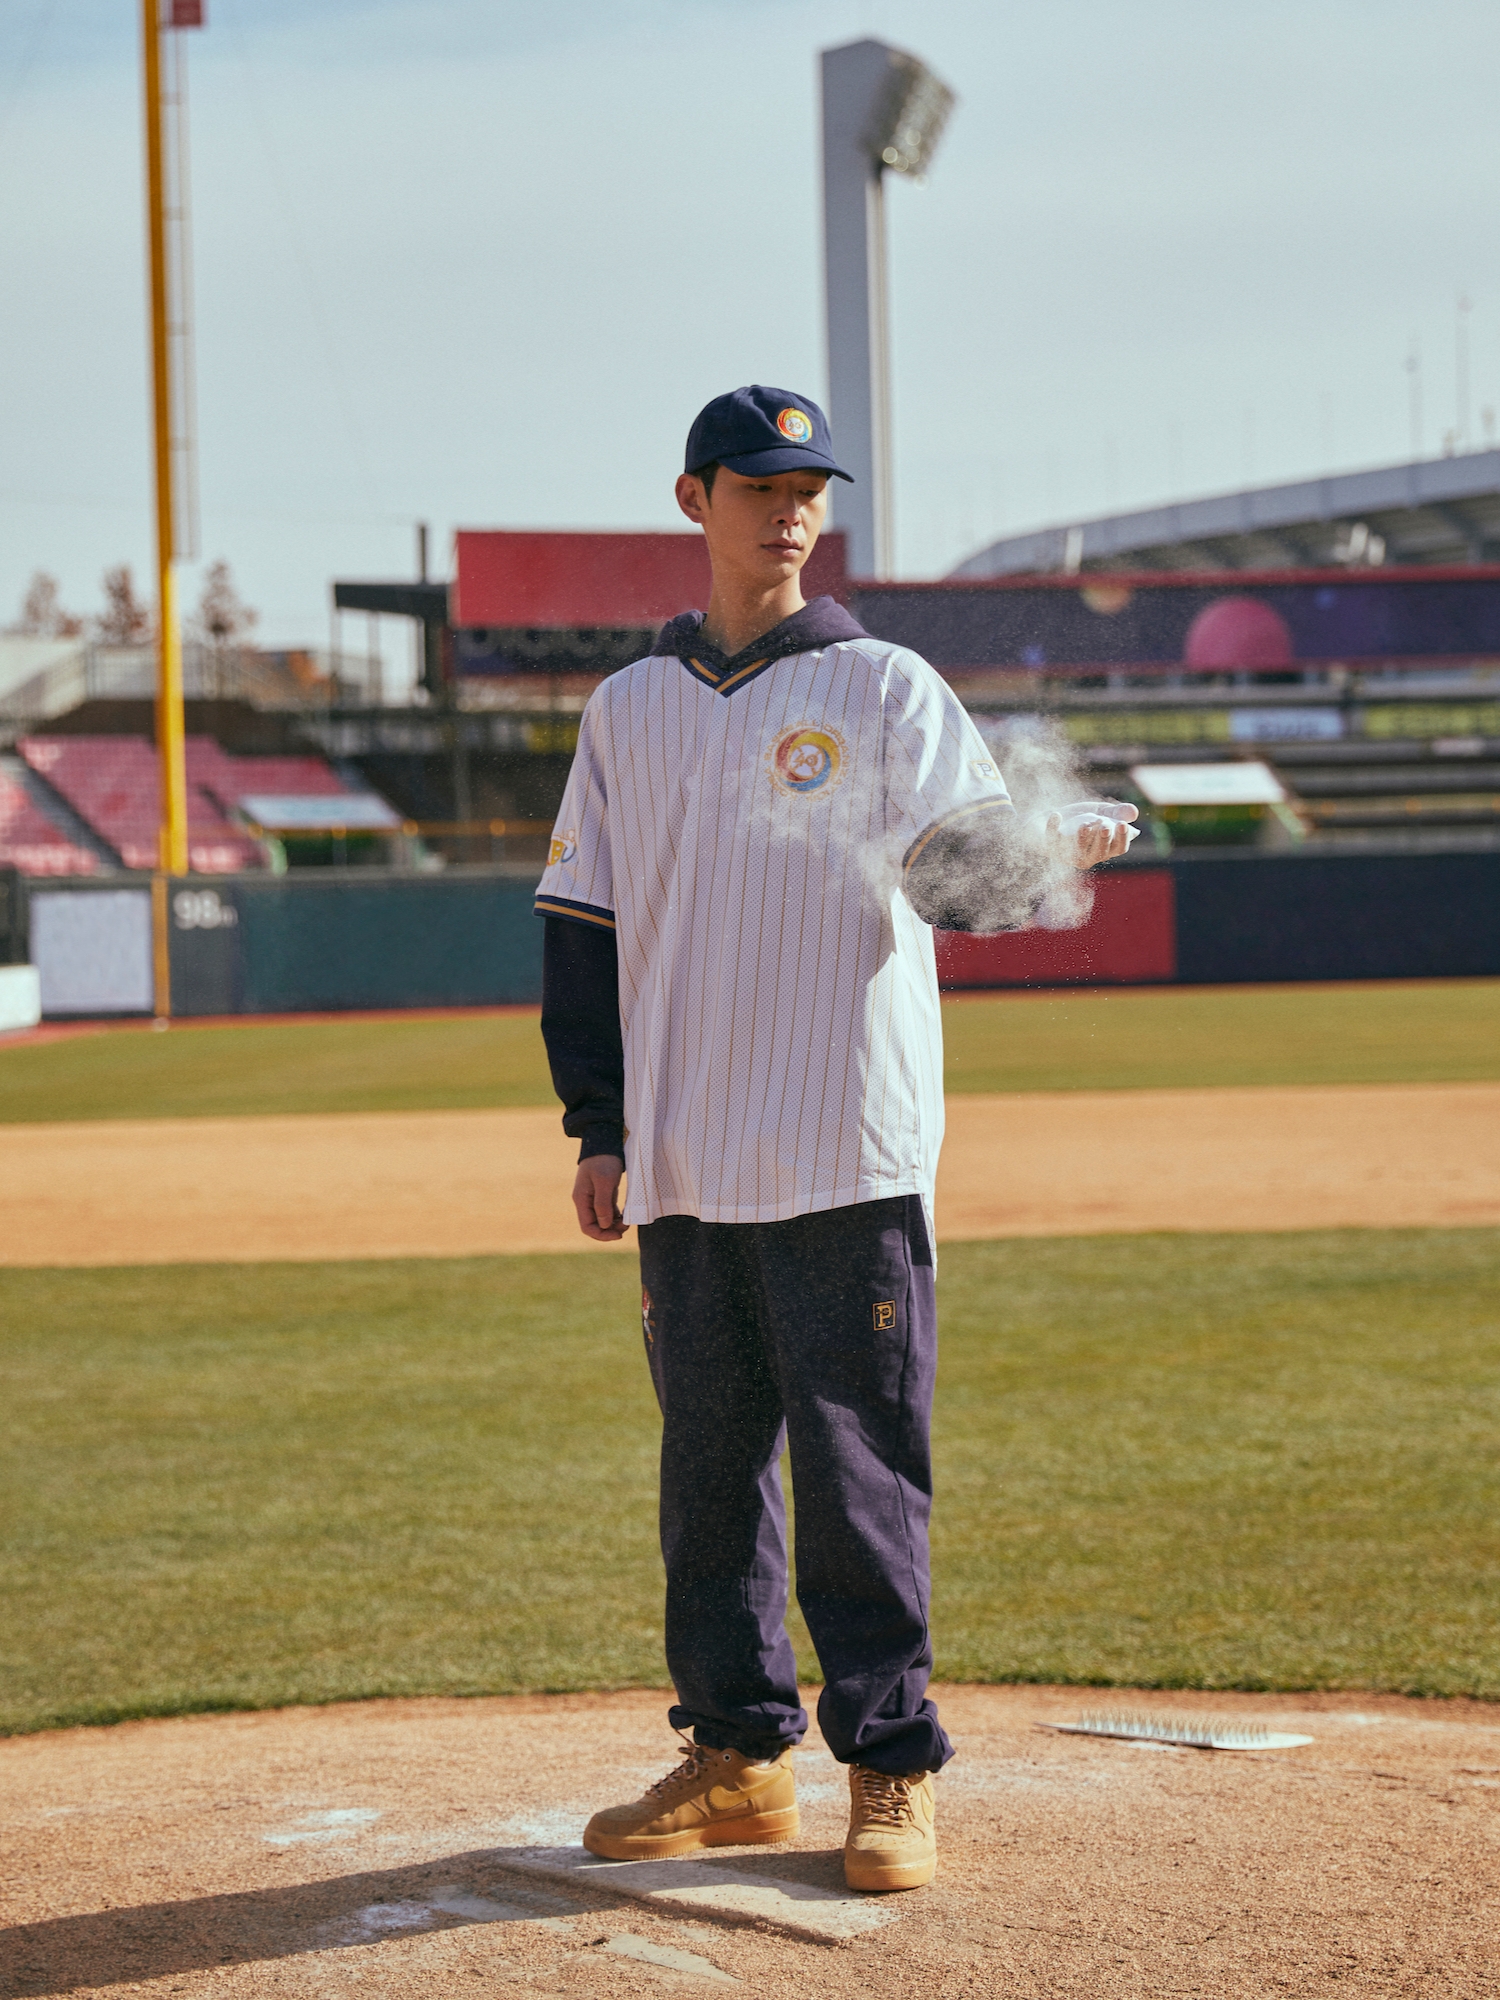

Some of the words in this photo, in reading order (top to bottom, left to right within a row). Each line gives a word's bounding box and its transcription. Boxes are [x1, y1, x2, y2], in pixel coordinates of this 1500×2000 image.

[764, 720, 819, 760] BASEBALL
[977, 763, 991, 776] P
[877, 1304, 893, 1327] P
